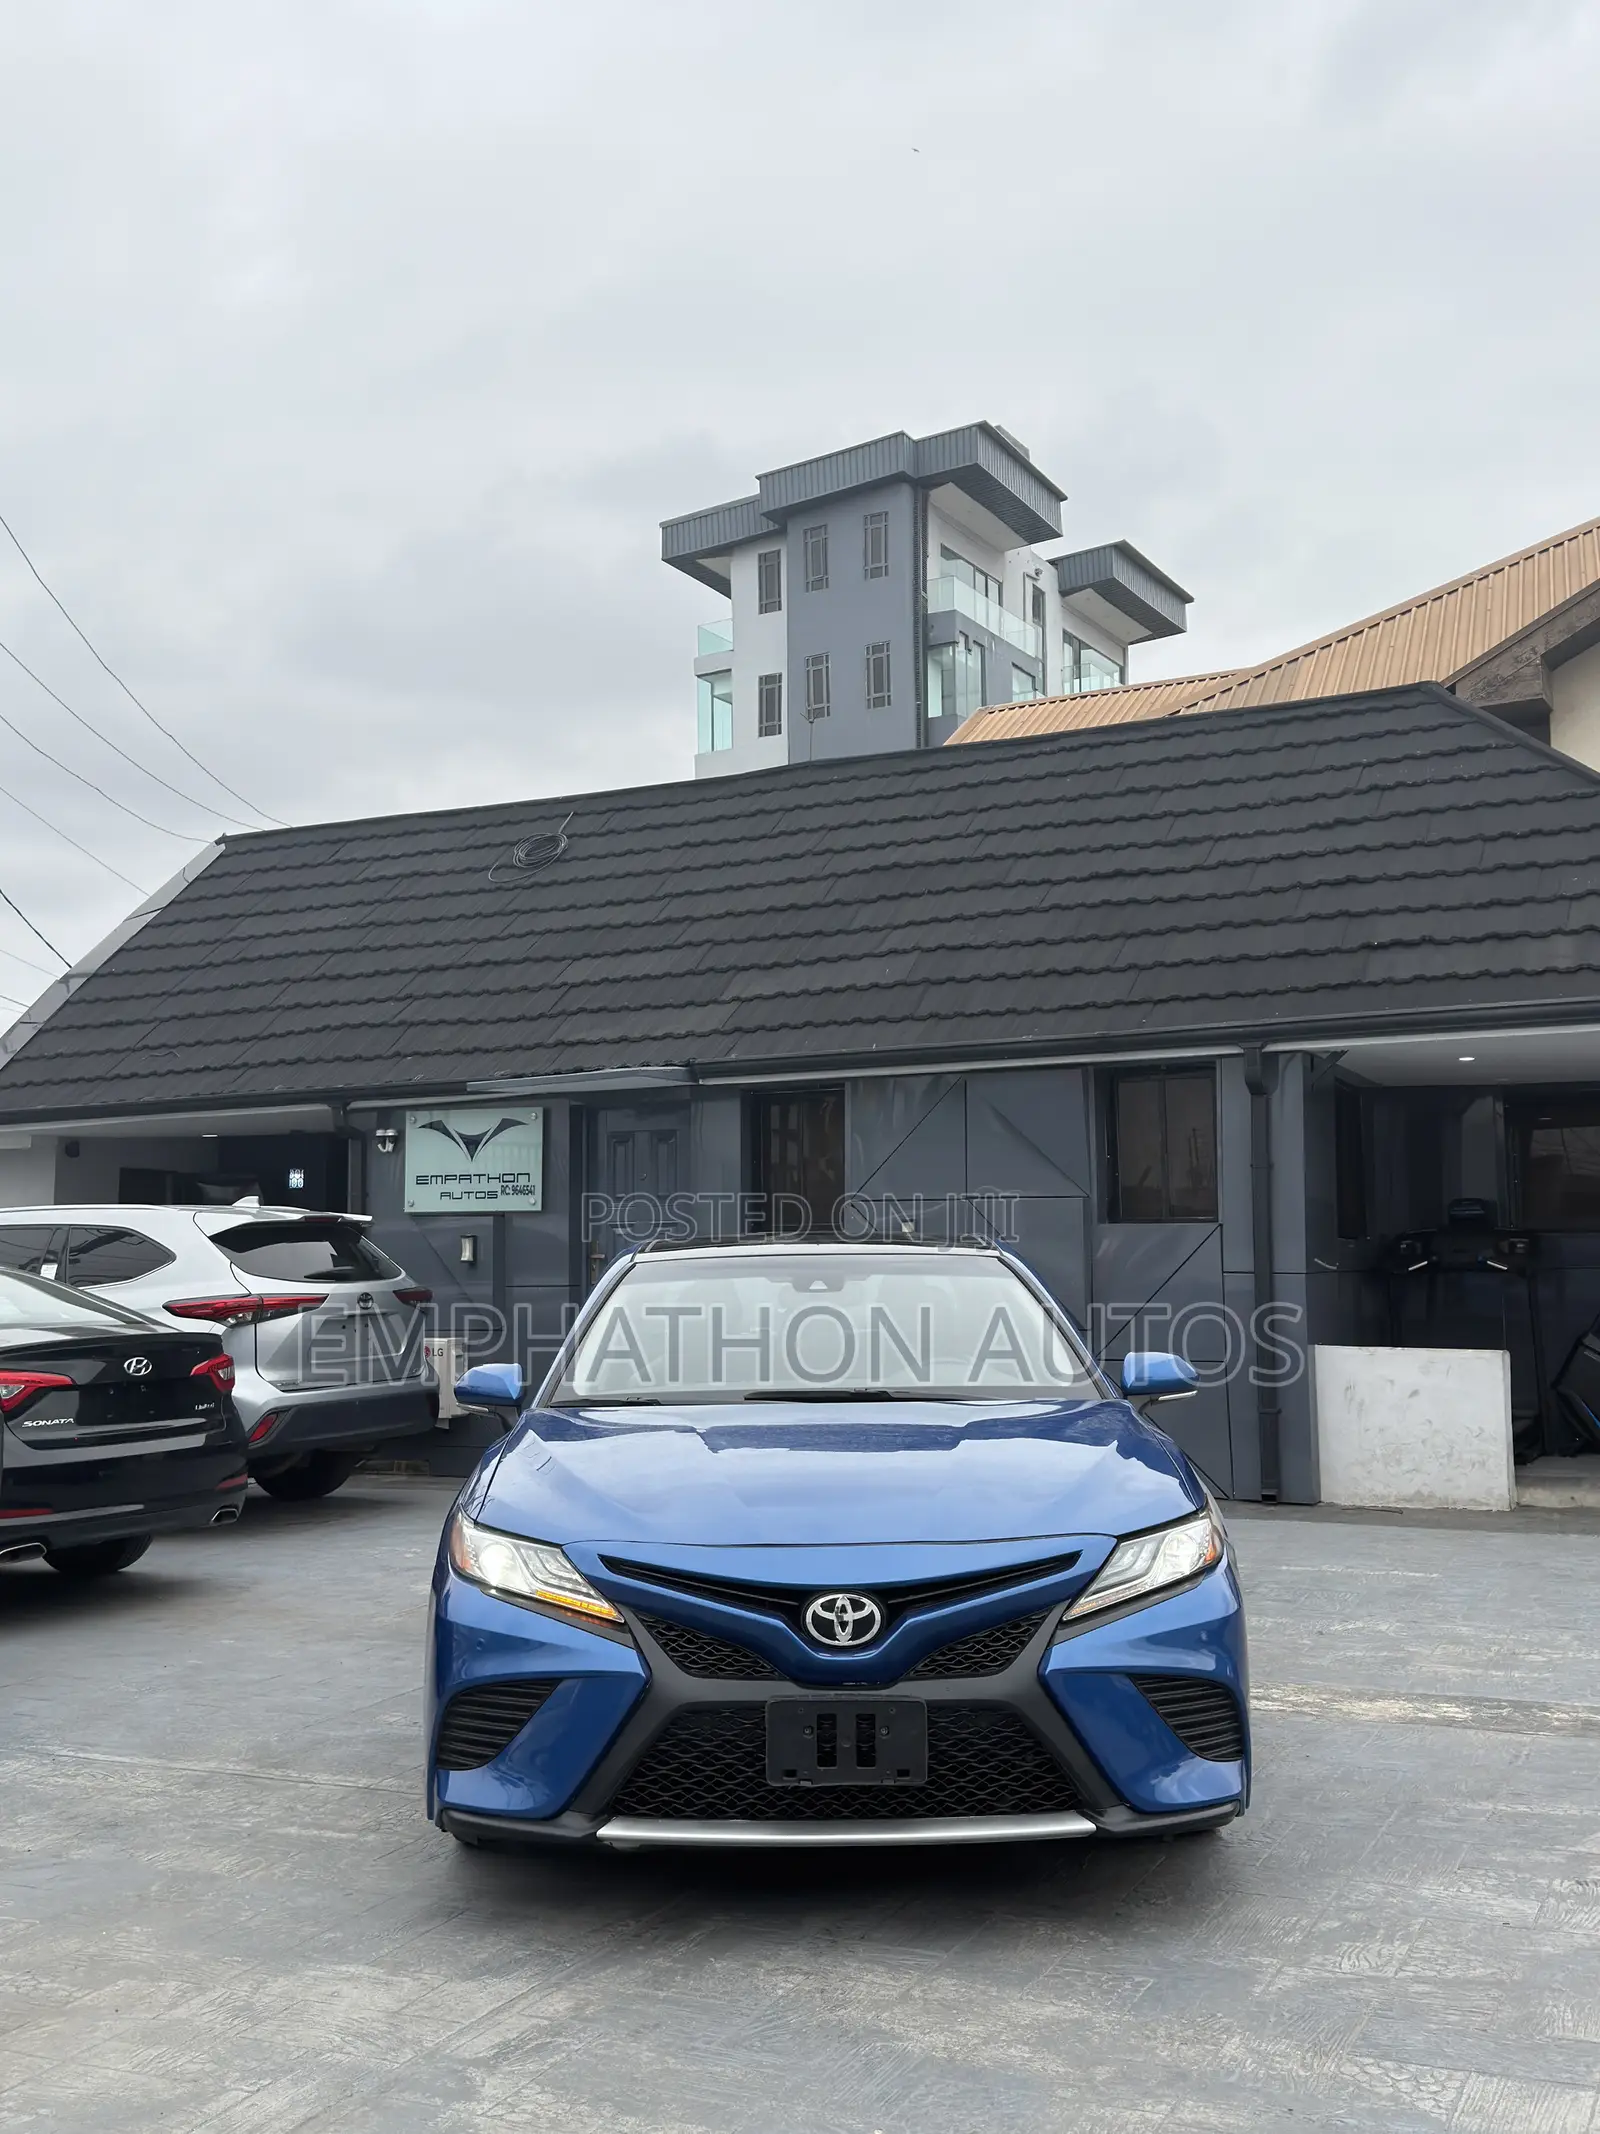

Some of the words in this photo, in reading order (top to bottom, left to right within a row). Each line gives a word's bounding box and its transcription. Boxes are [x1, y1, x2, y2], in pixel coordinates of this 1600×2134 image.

[415, 1173, 531, 1185] EMPATHON
[440, 1191, 498, 1200] AUTOS
[431, 1347, 444, 1357] LG
[21, 1417, 74, 1428] SONATA
